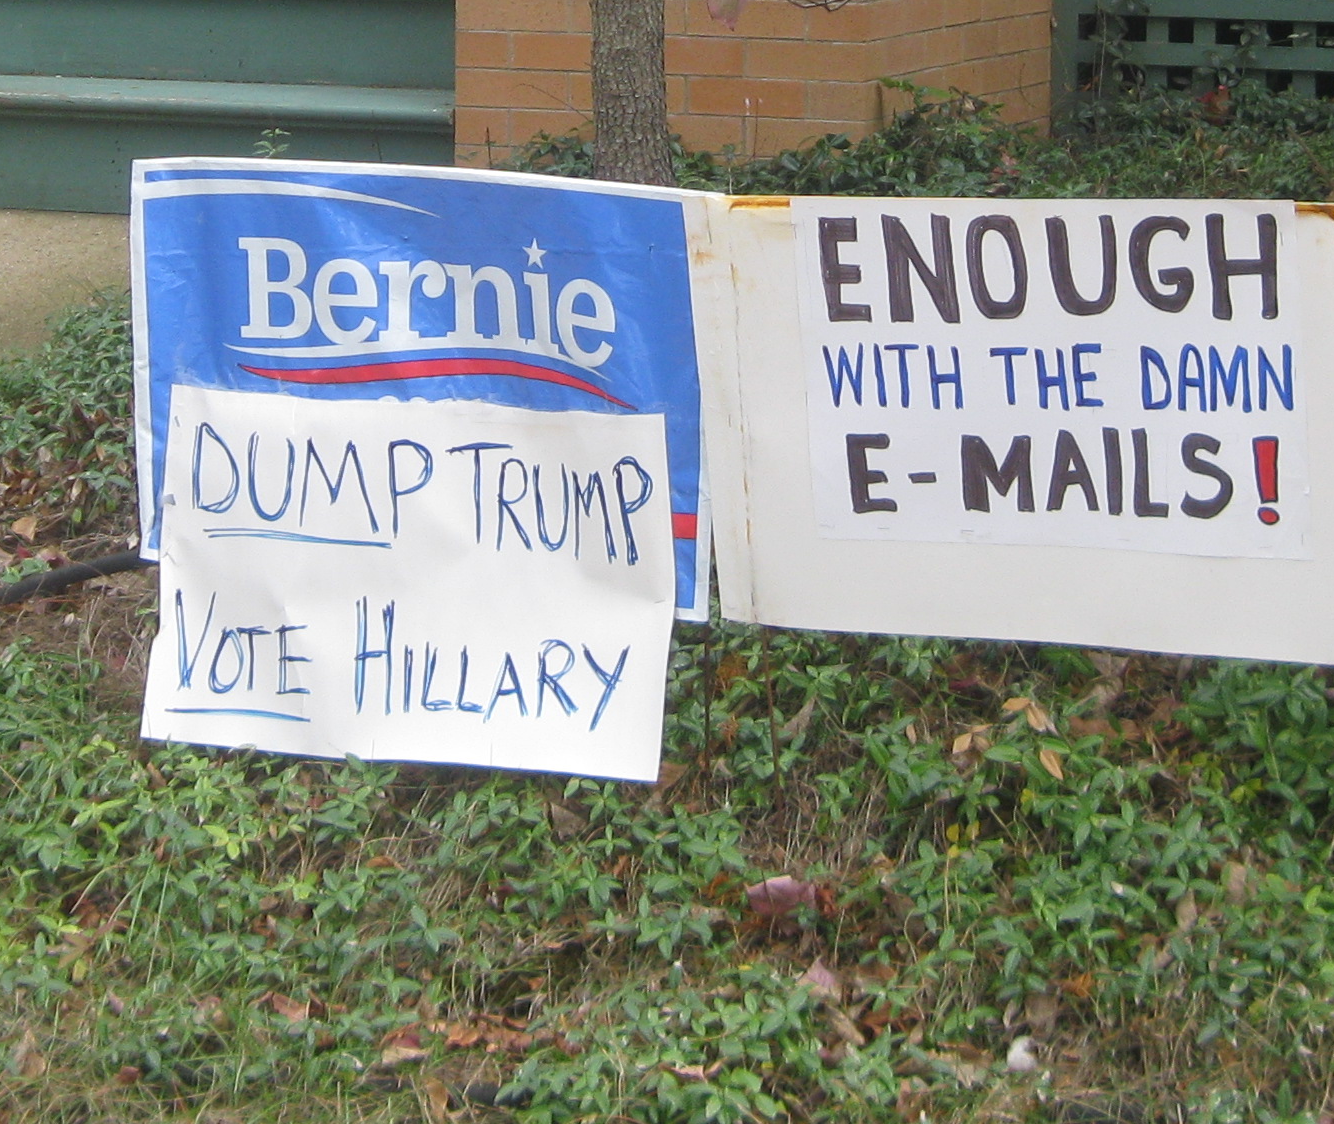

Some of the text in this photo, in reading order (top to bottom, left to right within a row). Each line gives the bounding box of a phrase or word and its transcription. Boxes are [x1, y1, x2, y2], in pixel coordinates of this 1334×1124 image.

[238, 237, 616, 368] Bernie
[818, 212, 1278, 323] ENOUGH
[822, 342, 1294, 412] WITH THE DAMN
[192, 421, 654, 566] DUMP TRUMP
[846, 427, 1280, 525] E-MAILS!
[174, 589, 631, 732] VOTE HILLARY
